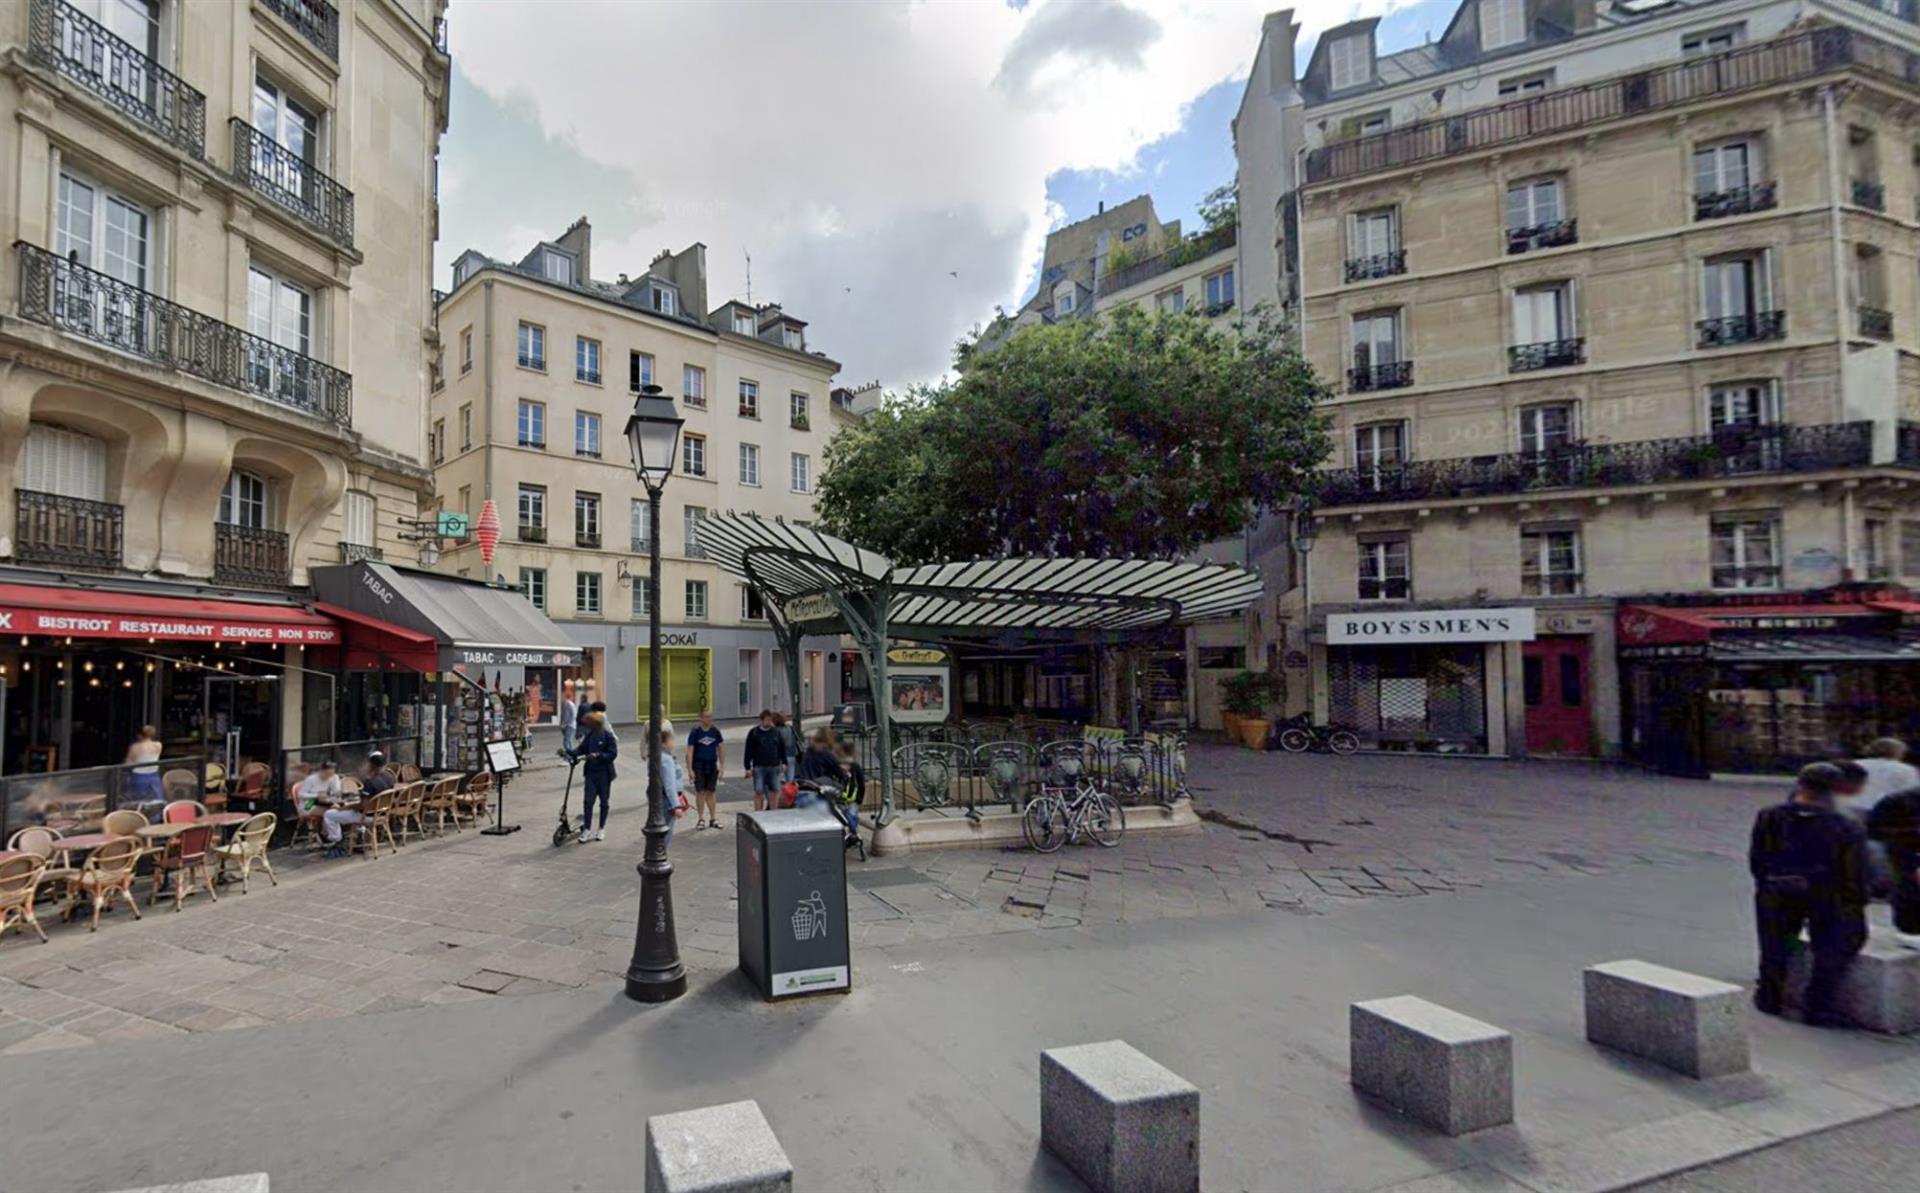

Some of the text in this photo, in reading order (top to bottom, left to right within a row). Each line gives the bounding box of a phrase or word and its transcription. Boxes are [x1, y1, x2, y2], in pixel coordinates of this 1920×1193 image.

[362, 571, 393, 604] TABAC
[38, 616, 112, 631] BISTROT
[119, 620, 214, 636] RESTAURANT
[222, 626, 272, 638] SERVICE
[278, 629, 303, 639] NON
[307, 630, 334, 640] STOP
[659, 632, 698, 646] OOKAÏ
[463, 651, 495, 663] TABAC
[505, 652, 544, 664] CADEAUX
[698, 655, 707, 710] OOKAÏ
